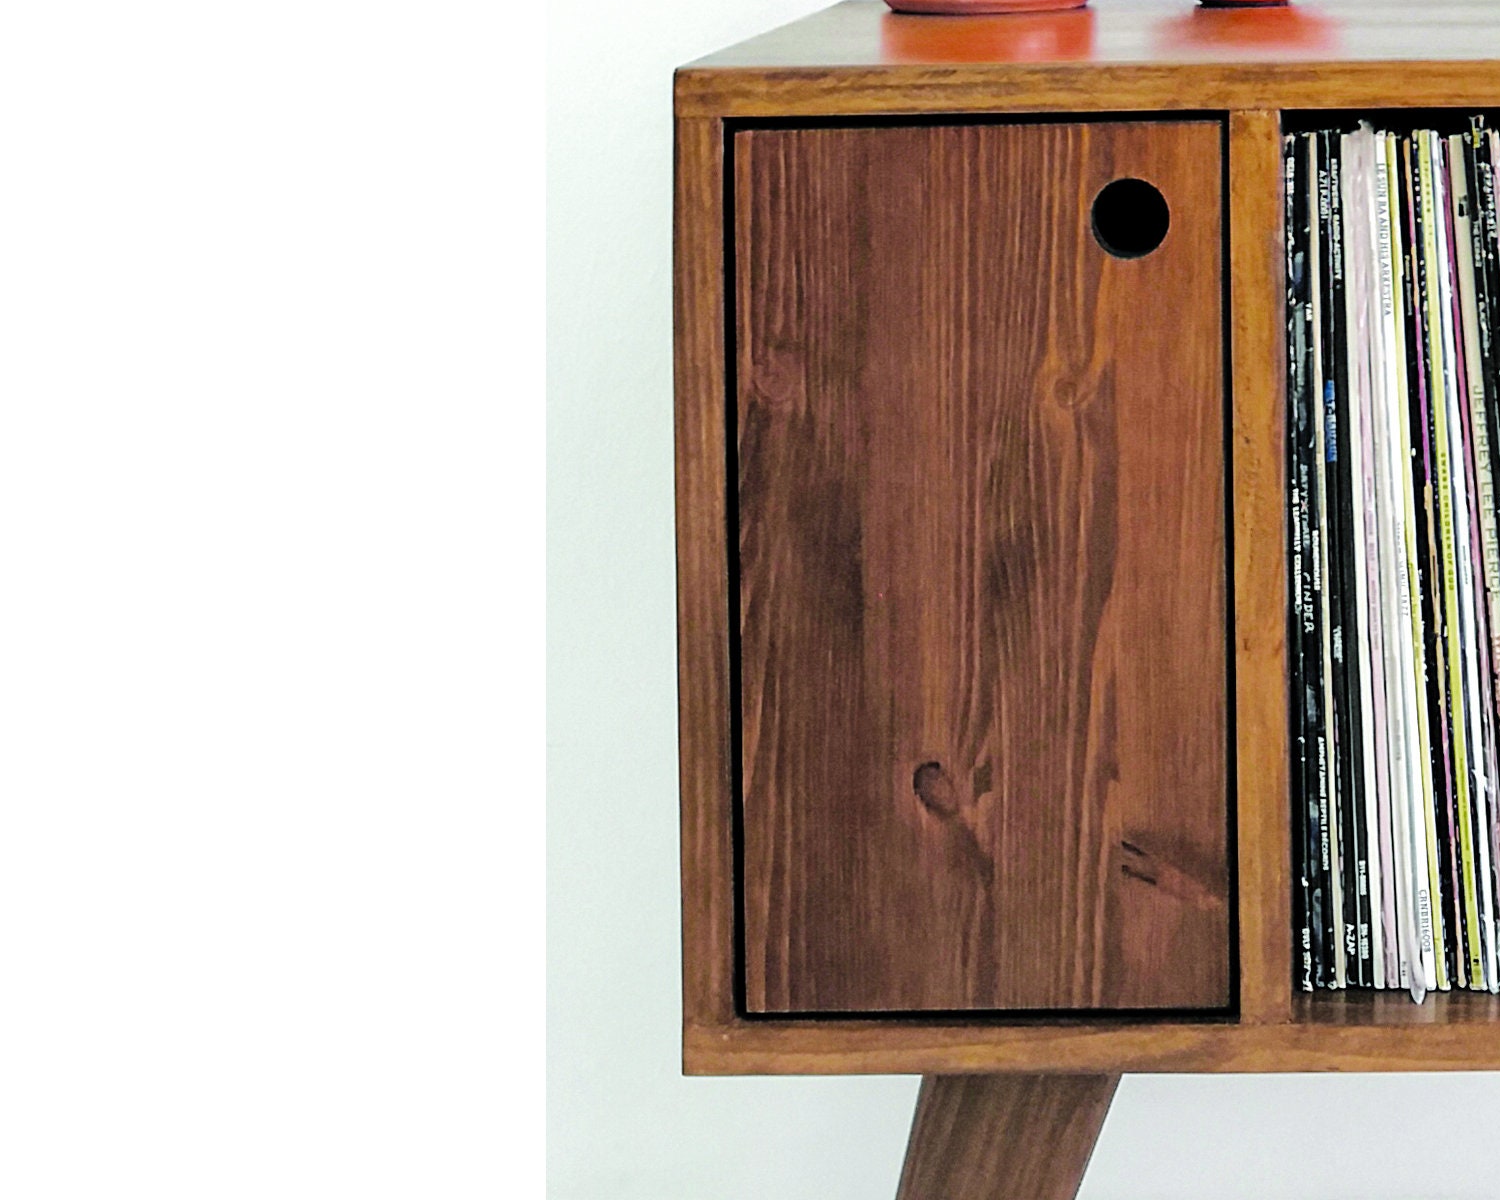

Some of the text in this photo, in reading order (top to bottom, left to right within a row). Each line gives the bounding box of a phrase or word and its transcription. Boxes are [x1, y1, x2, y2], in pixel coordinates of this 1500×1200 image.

[1331, 158, 1340, 208] KRAFTWERK
[1376, 163, 1392, 317] LE SUN RA AND HIS ARKESTRA
[1473, 386, 1491, 478] JEFFREY
[1481, 482, 1495, 516] LEE
[1443, 496, 1453, 550] CHILDREN
[1446, 553, 1453, 566] OF
[1446, 570, 1455, 591] GOD
[1318, 736, 1327, 797] AMPHETAMINE
[1320, 800, 1328, 831] REPTILE
[1346, 924, 1356, 956] A-ZAP
